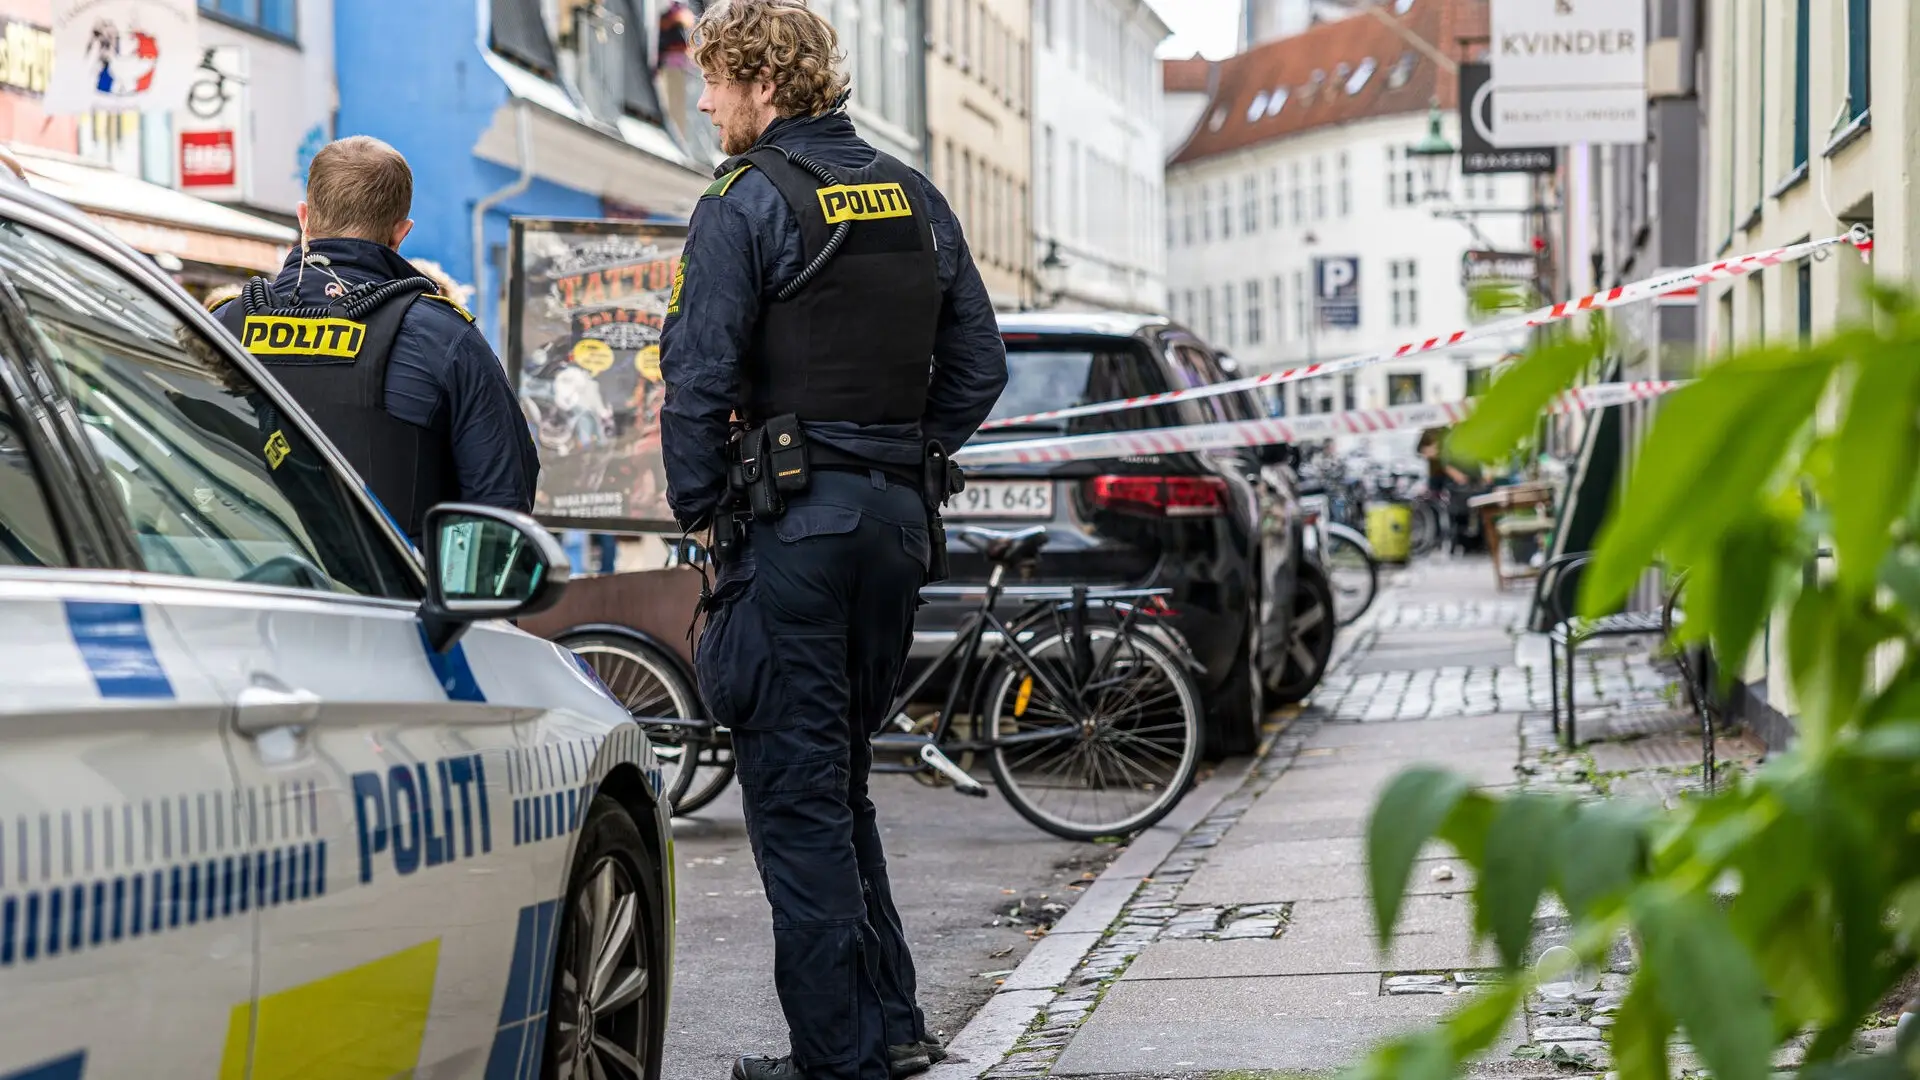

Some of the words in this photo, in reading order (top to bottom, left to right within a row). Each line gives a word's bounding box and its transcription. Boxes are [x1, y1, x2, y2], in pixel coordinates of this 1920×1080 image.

[1502, 29, 1636, 56] KVINDER
[823, 189, 908, 218] POLITI
[1323, 259, 1355, 299] P
[243, 322, 363, 352] POLITI
[967, 487, 991, 508] 91
[1003, 486, 1046, 508] 645
[351, 754, 491, 885] POLITI
